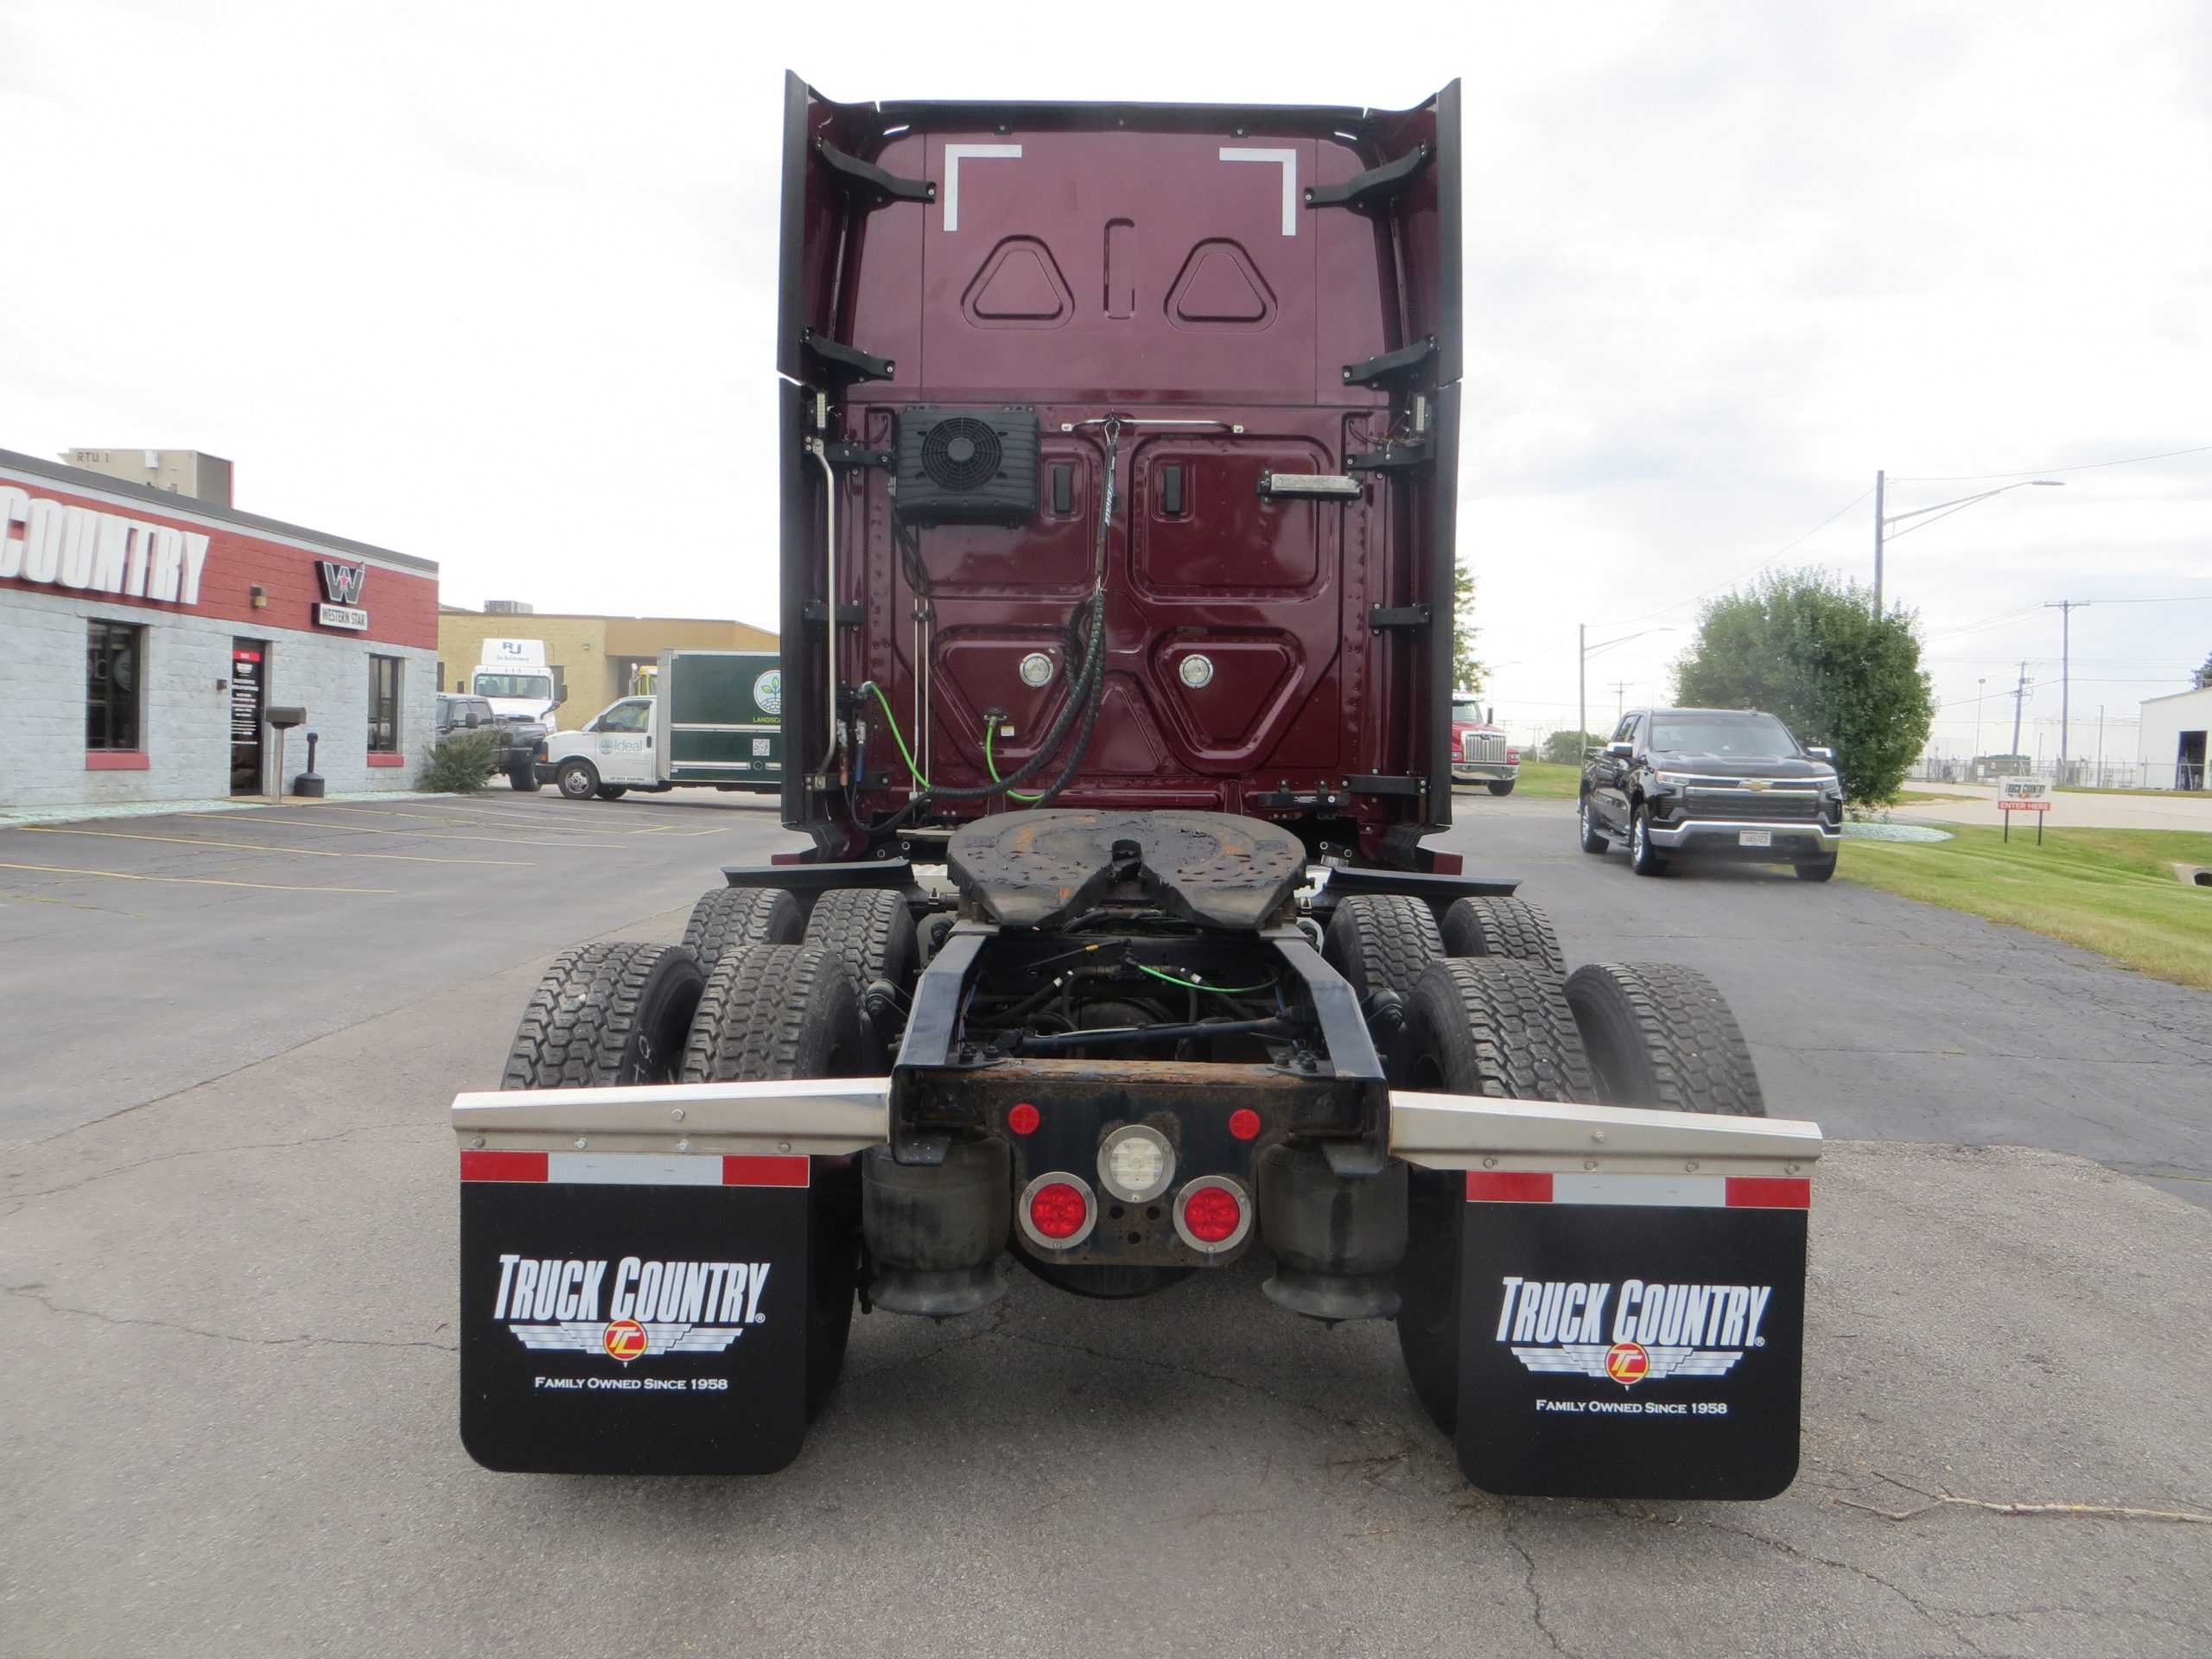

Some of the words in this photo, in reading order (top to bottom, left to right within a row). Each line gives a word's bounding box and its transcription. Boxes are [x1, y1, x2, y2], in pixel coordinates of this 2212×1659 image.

[77, 452, 99, 462] RTU
[105, 453, 109, 462] 1
[0, 486, 210, 605] COUNTRY
[322, 608, 349, 623] WESTERN
[351, 613, 365, 626] STAR
[503, 642, 522, 654] RJ
[615, 740, 642, 752] Ideal
[2005, 783, 2022, 792] TRUCK
[2022, 784, 2046, 793] COUNTRY
[494, 1255, 607, 1320] TRUCK
[611, 1256, 771, 1323] COUNTRY
[1496, 1276, 1611, 1343] TRUCK
[1612, 1279, 1771, 1347] COUNTRY
[690, 1379, 728, 1390] 1958
[1691, 1403, 1728, 1415] 1958
